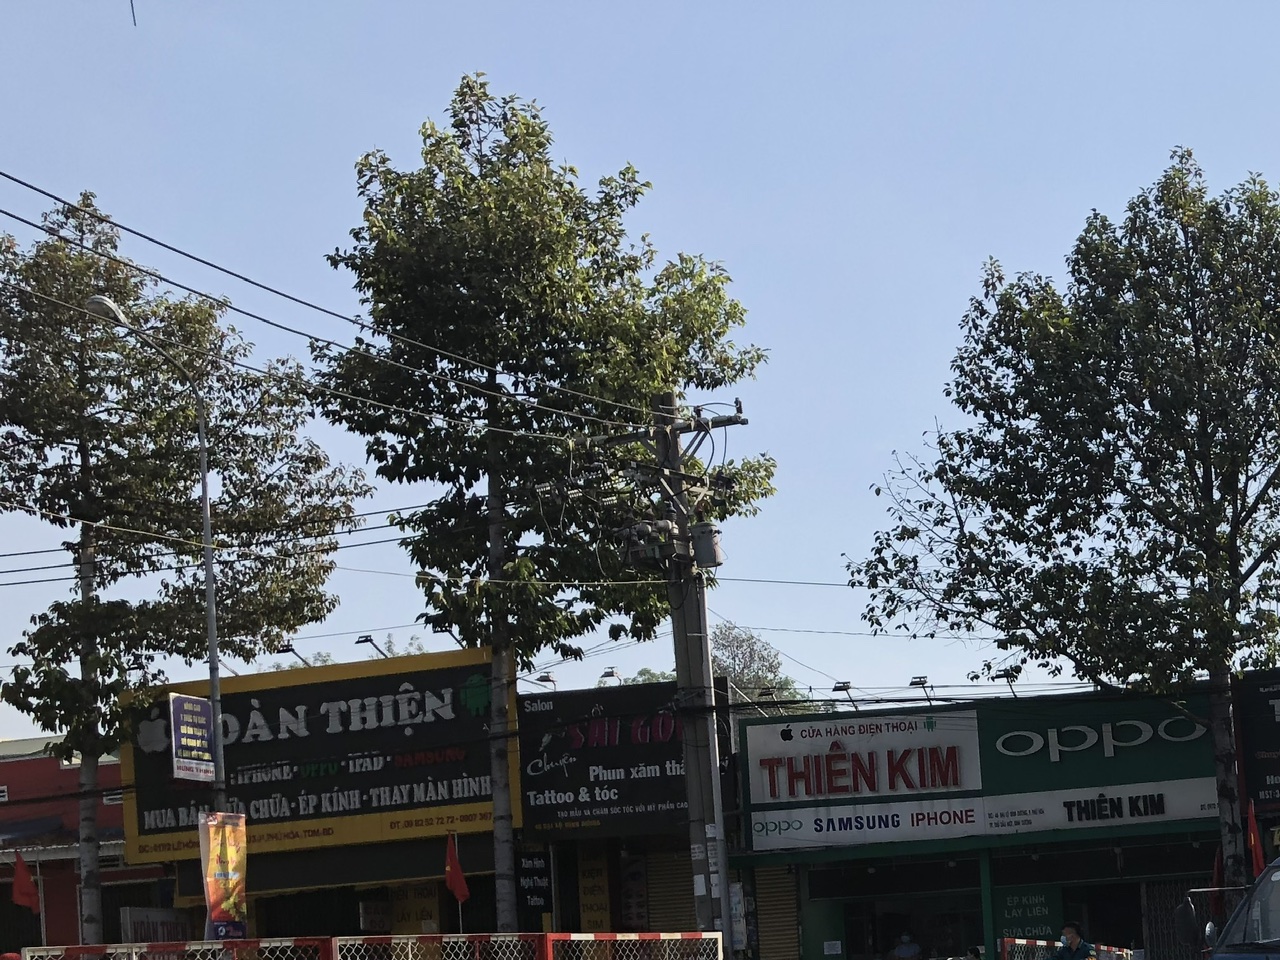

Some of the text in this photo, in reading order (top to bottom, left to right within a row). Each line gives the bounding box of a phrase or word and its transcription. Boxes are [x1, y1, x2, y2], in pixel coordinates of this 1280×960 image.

[221, 681, 456, 746] OÀN THIỆN
[524, 700, 553, 713] Salon
[800, 721, 918, 739] CỬA HÀNG ĐIỆN THOẠI
[527, 753, 577, 777] Chuyên
[589, 765, 625, 782] Phun
[630, 763, 660, 779] xăm
[760, 740, 960, 798] THIÊN KIM
[144, 808, 176, 830] MUA
[251, 793, 291, 820] CHỮA
[299, 789, 317, 815] ÉP
[321, 786, 361, 813] KÍNH
[369, 784, 411, 807] THAY
[413, 776, 449, 802] MÀN
[451, 772, 492, 799] HÌNH
[527, 785, 618, 806] Tattoo & tóc
[1063, 793, 1123, 822] THIÊN
[1128, 793, 1166, 818] KIM
[753, 819, 803, 836] oppo
[814, 813, 900, 832] SAMSUNG
[911, 809, 976, 827] IPHONE
